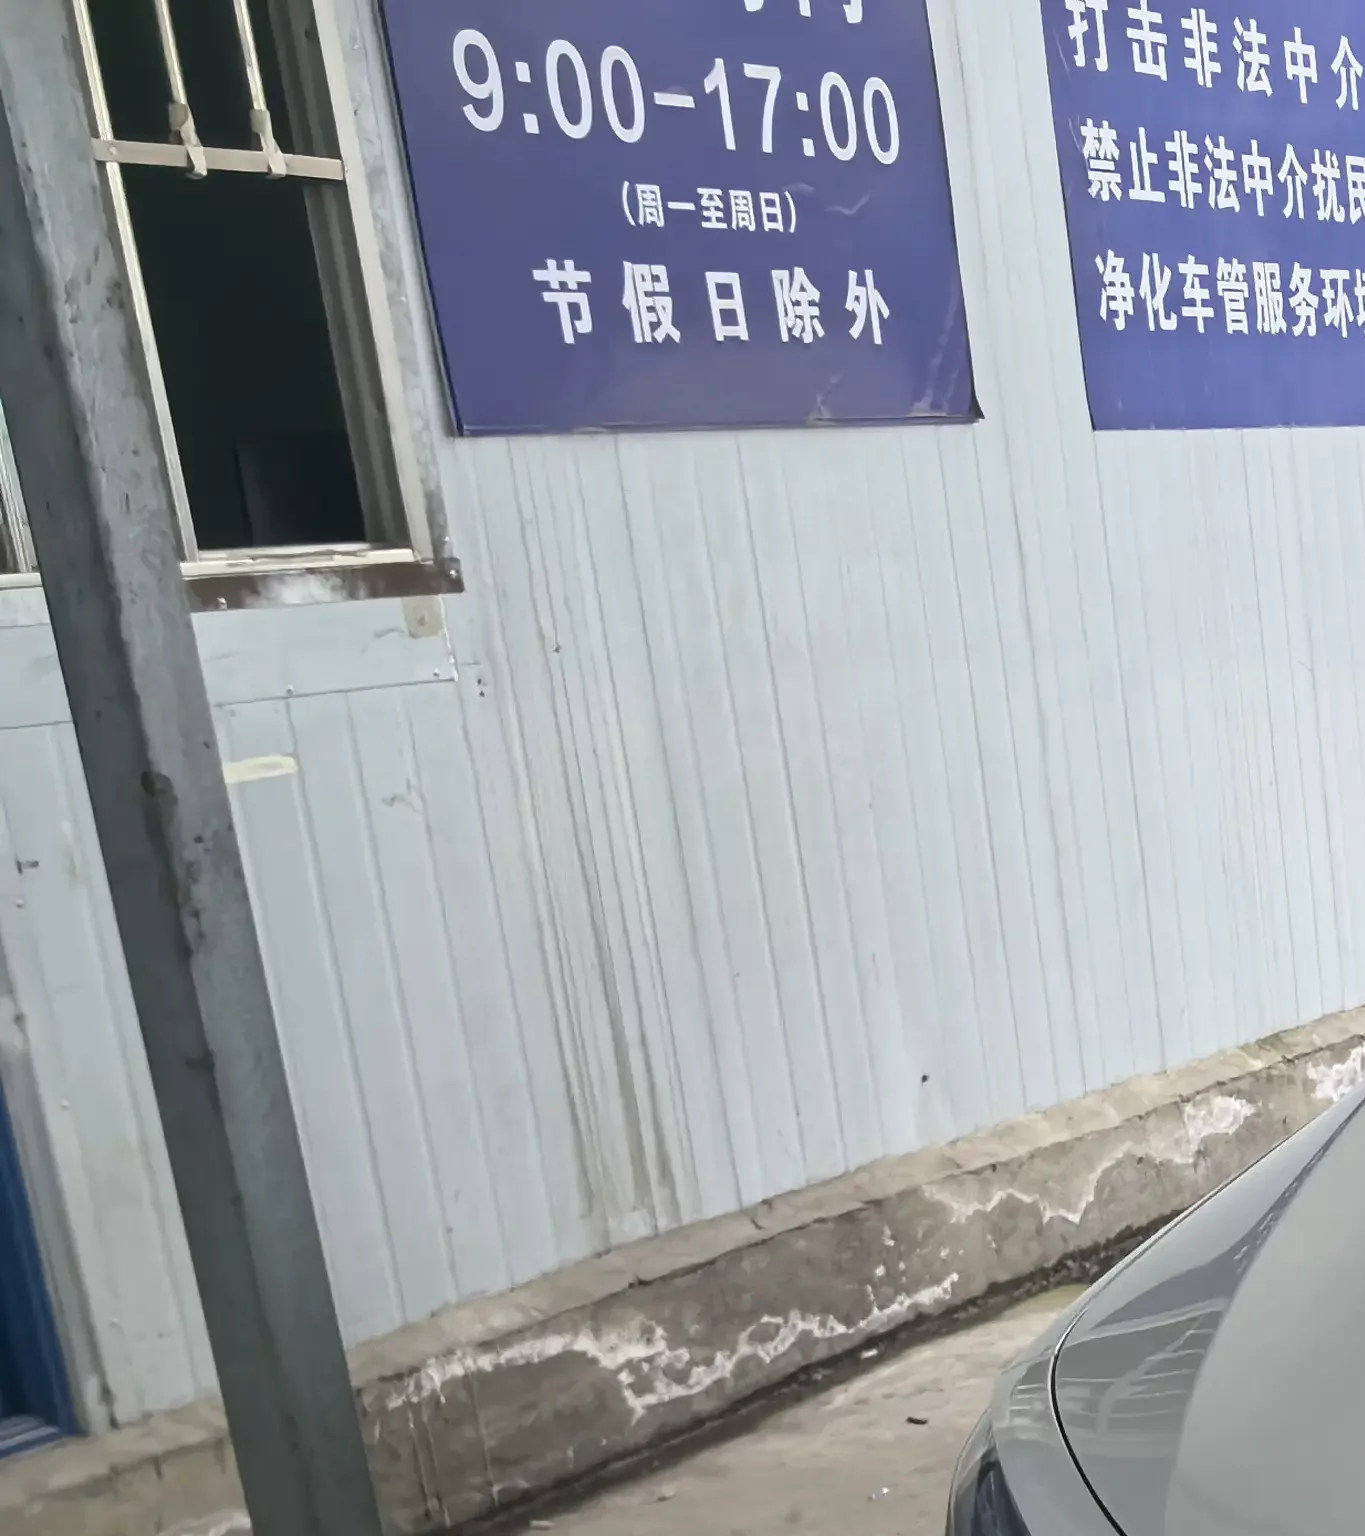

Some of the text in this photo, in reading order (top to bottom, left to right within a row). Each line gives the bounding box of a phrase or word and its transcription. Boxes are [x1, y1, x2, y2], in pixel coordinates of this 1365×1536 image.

[452, 28, 900, 165] 9:00-17:00
[1065, 0, 1364, 111] 打击非法中介
[621, 180, 797, 233] (周一至周日)
[531, 257, 891, 345] 节假日除外
